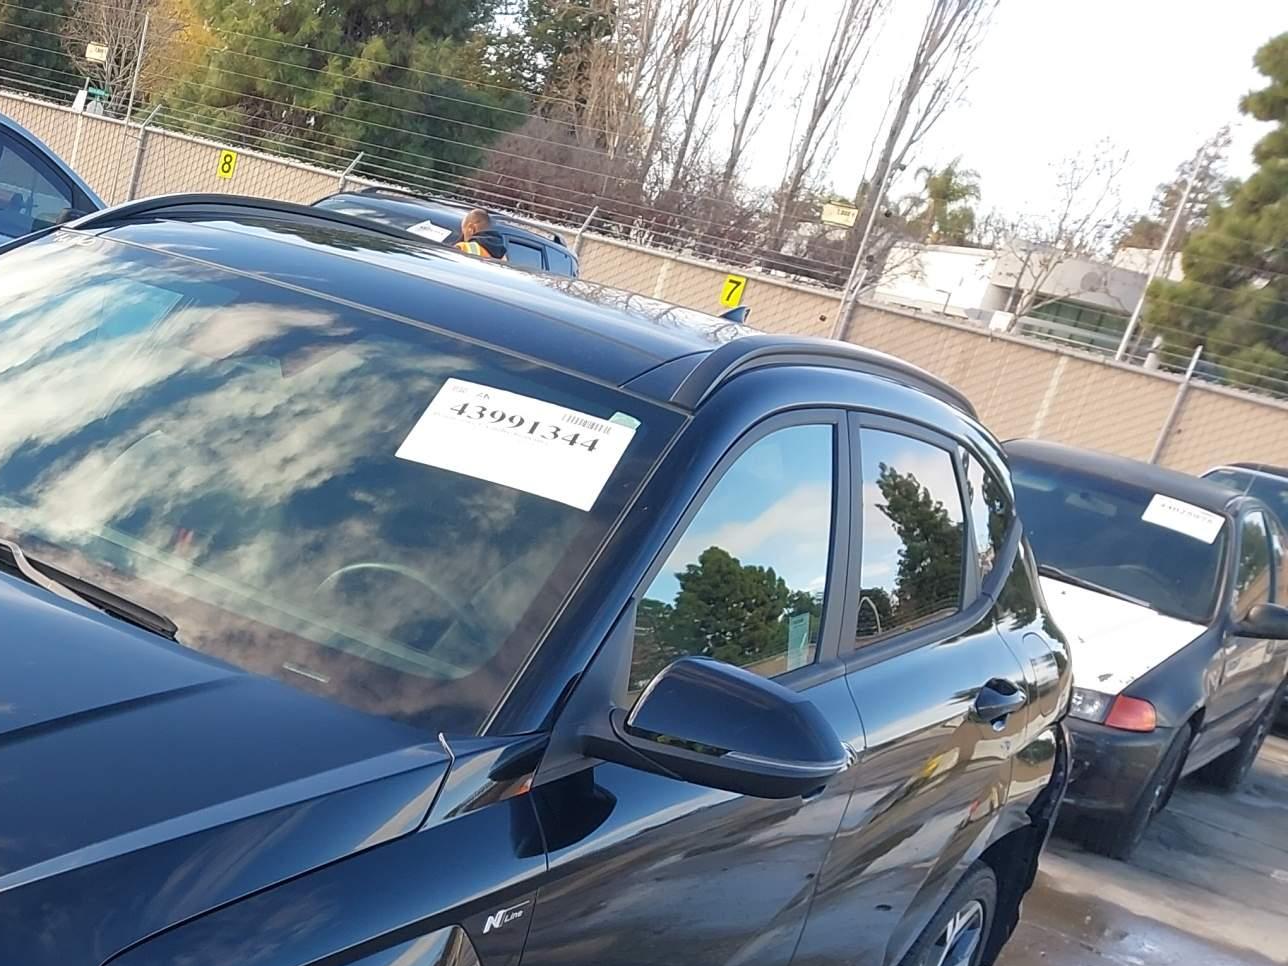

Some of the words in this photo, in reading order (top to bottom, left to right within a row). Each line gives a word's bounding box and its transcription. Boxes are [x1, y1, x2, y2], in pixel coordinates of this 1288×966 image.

[222, 154, 233, 174] 8
[726, 279, 742, 302] 7
[450, 403, 600, 452] 43991344
[483, 909, 505, 934] N
